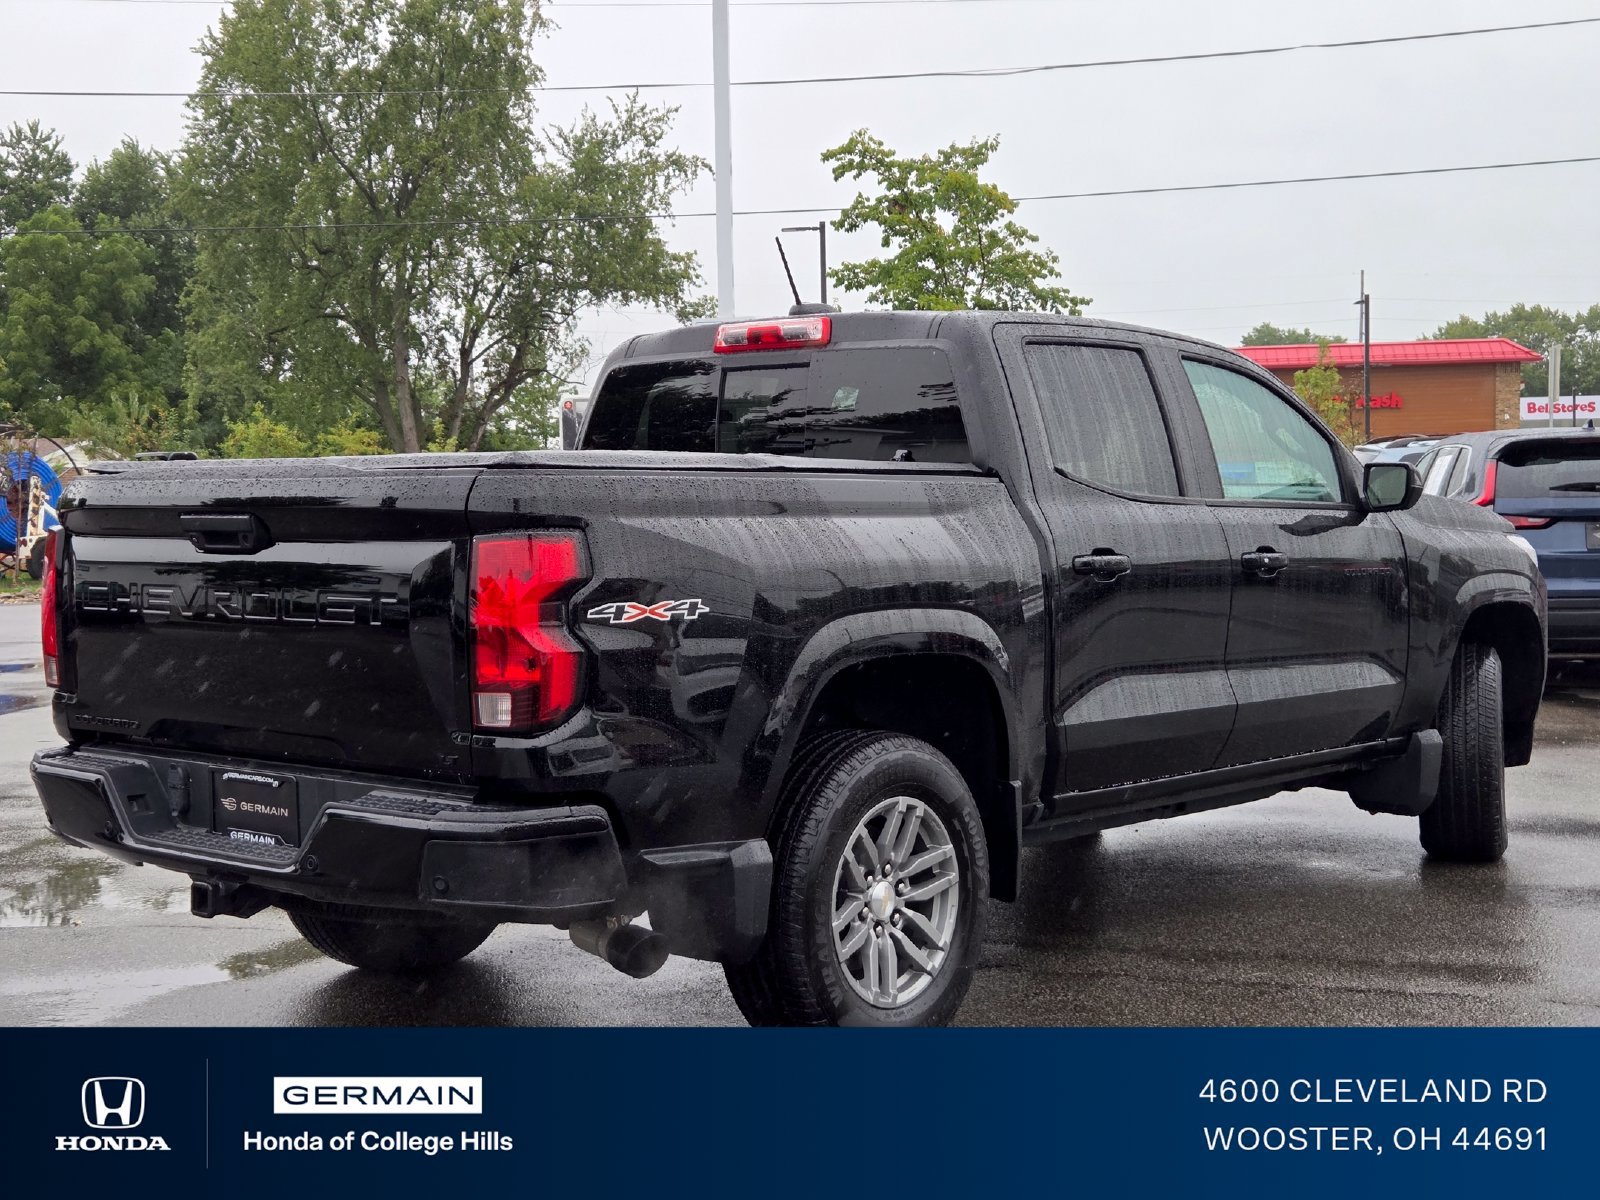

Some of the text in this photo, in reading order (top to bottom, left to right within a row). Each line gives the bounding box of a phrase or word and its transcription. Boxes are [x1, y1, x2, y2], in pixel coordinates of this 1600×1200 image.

[1527, 402, 1551, 414] Bel
[79, 581, 399, 626] CHEVROLET
[240, 801, 289, 817] GERMAIN
[230, 830, 275, 845] GERMAIN
